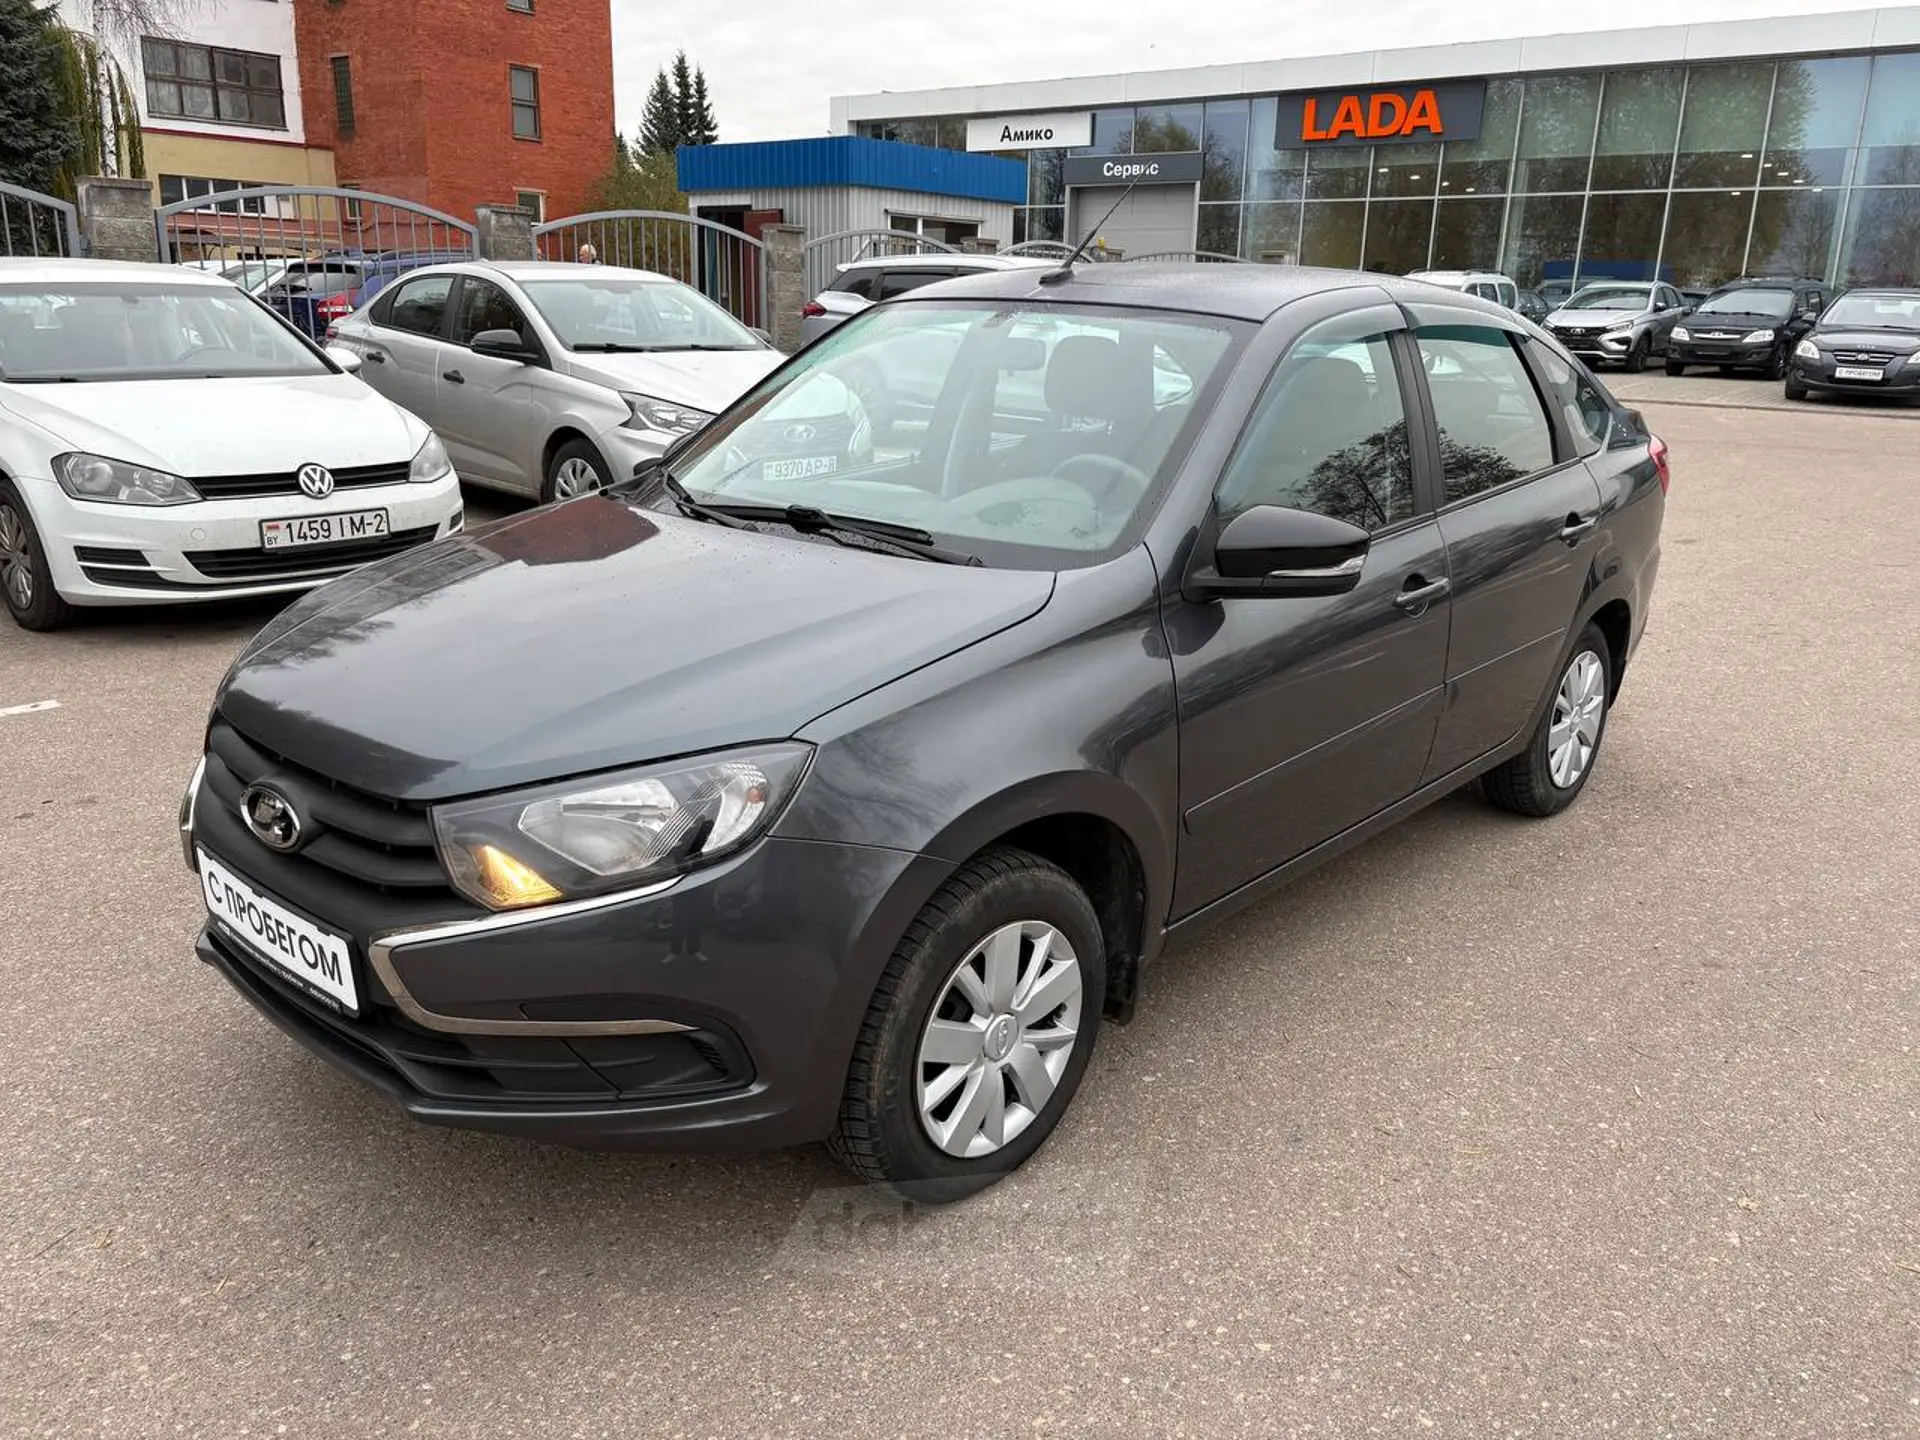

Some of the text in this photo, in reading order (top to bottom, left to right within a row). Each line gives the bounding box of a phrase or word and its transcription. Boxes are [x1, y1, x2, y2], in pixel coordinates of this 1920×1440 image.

[1302, 89, 1443, 141] LADA
[1000, 125, 1054, 142] Амико
[1103, 162, 1159, 179] Сервис
[266, 537, 278, 545] BY
[286, 519, 332, 543] 1459
[208, 871, 222, 903] С
[225, 883, 343, 986] ПРОБЕГОМ
